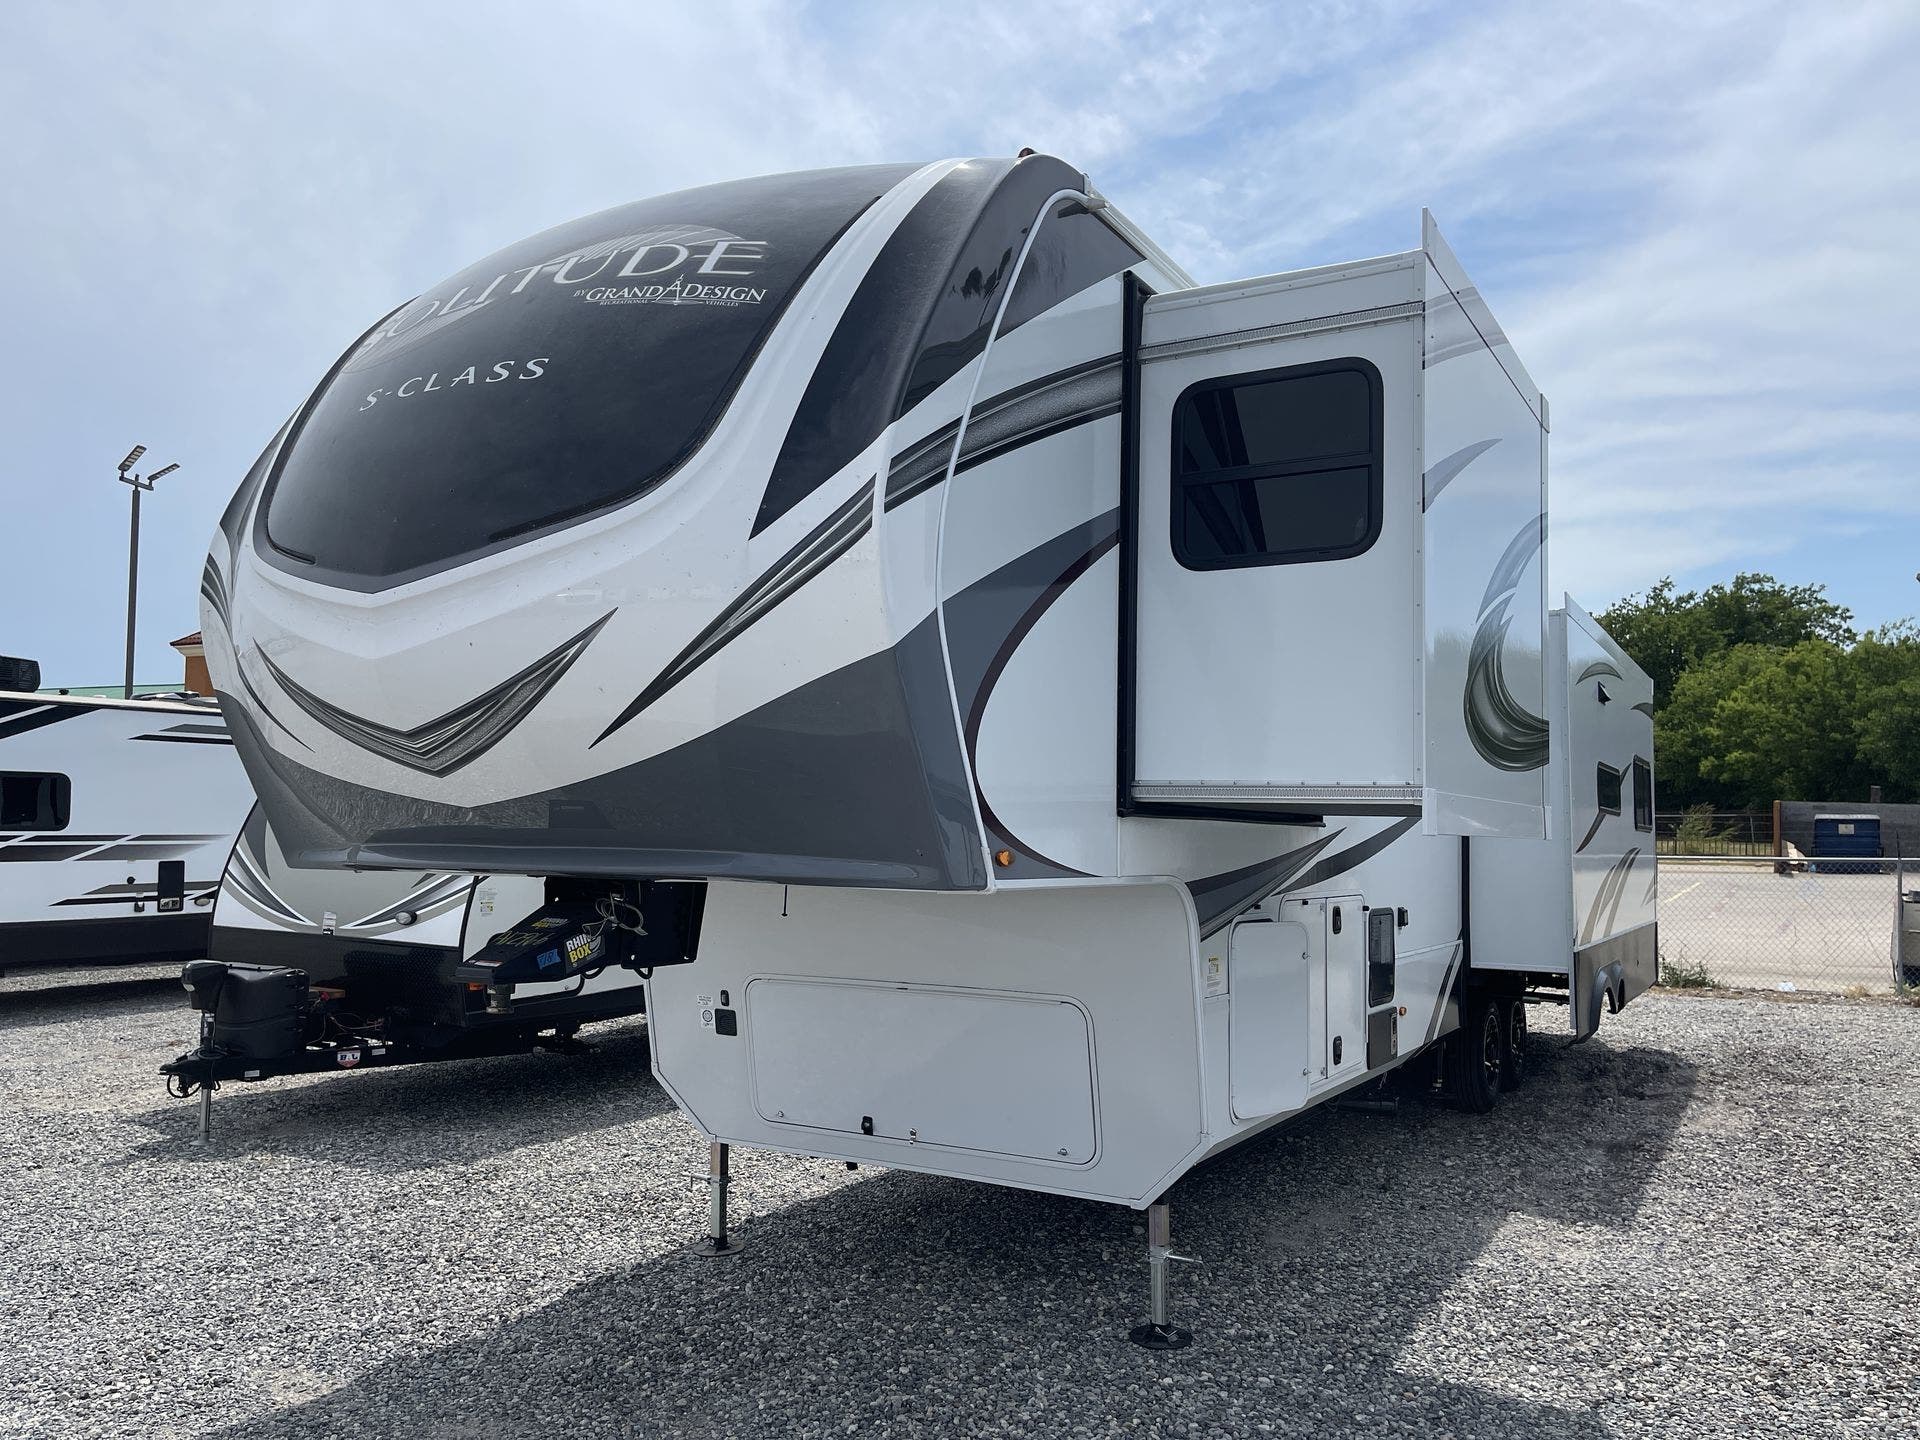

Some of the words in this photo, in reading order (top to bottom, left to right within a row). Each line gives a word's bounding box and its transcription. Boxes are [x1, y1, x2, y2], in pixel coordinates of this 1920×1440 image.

[573, 288, 588, 297] BY
[586, 286, 663, 301] GRAND
[681, 283, 768, 302] DESIGN
[360, 358, 549, 411] S-CLASS
[566, 933, 595, 952] RHIN
[568, 943, 592, 963] BOX
